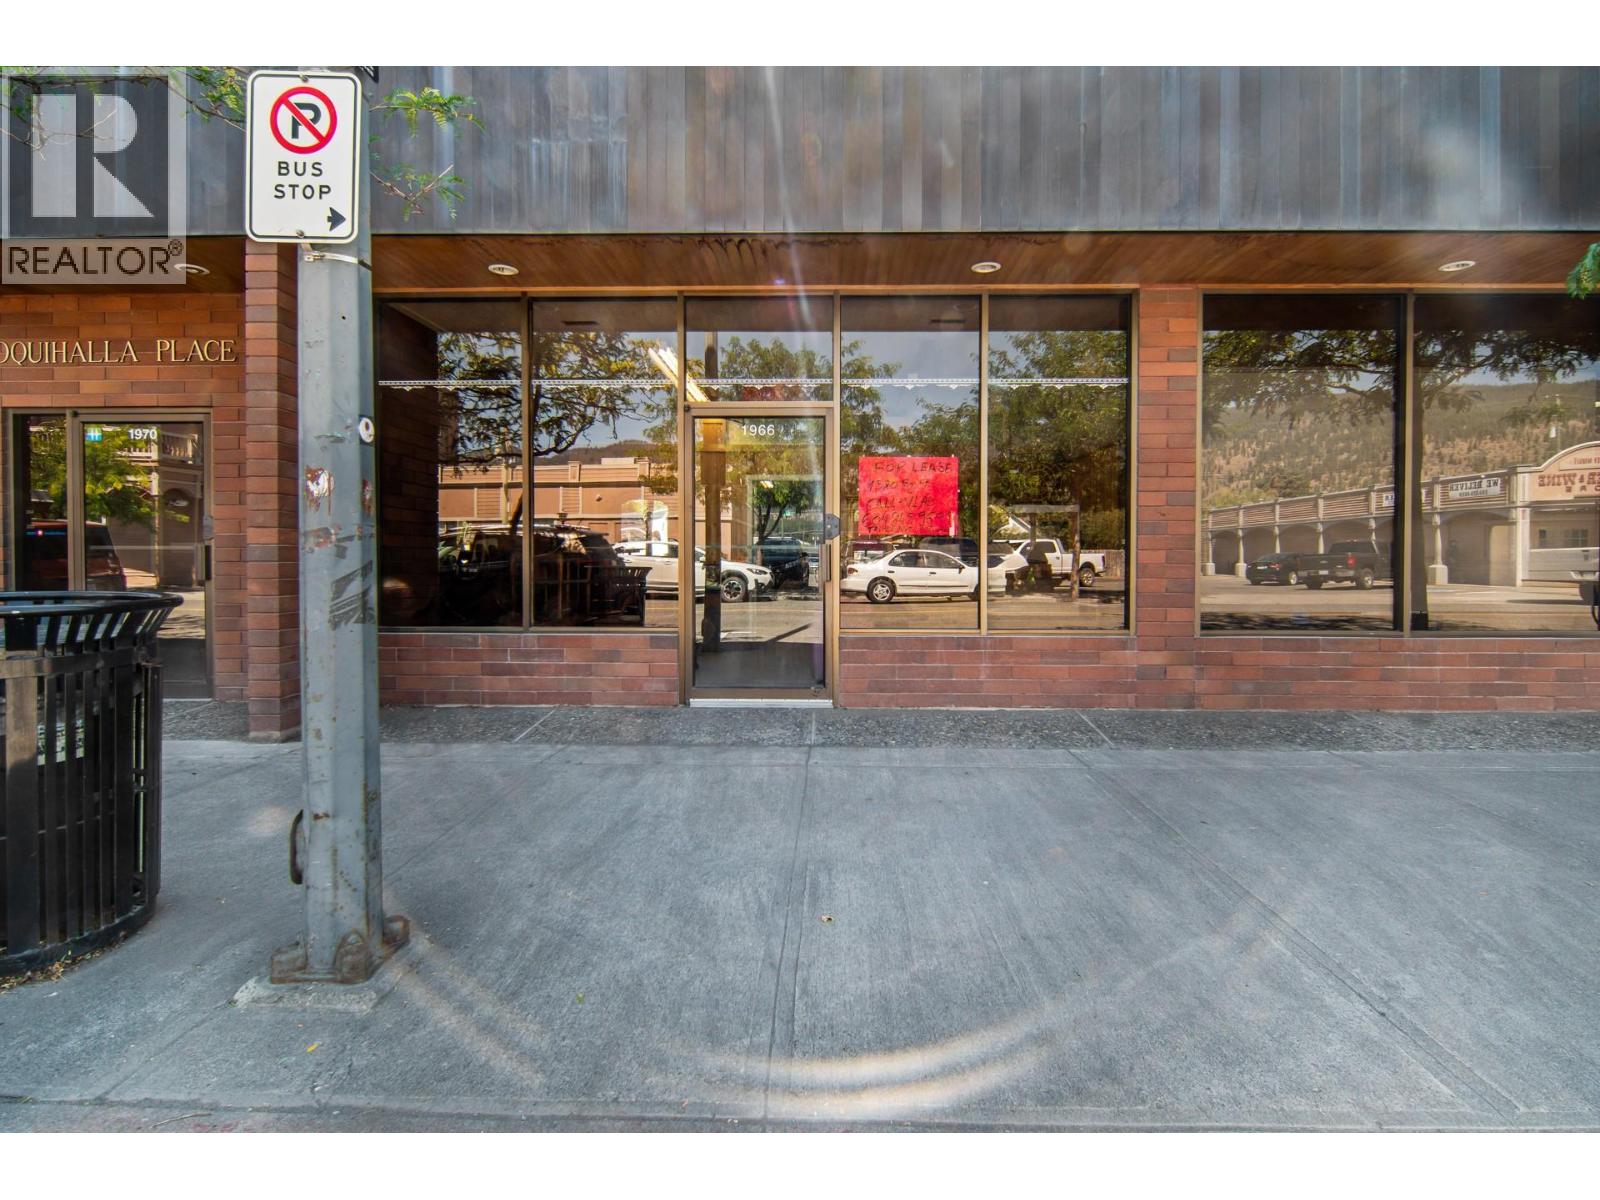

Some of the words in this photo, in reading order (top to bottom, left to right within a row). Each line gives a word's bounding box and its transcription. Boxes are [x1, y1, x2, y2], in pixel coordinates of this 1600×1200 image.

[277, 161, 324, 177] BUS
[273, 184, 332, 200] STOP
[156, 339, 237, 362] PLACE
[128, 428, 158, 440] 1970
[741, 424, 776, 436] 1966
[911, 461, 952, 474] LEASE
